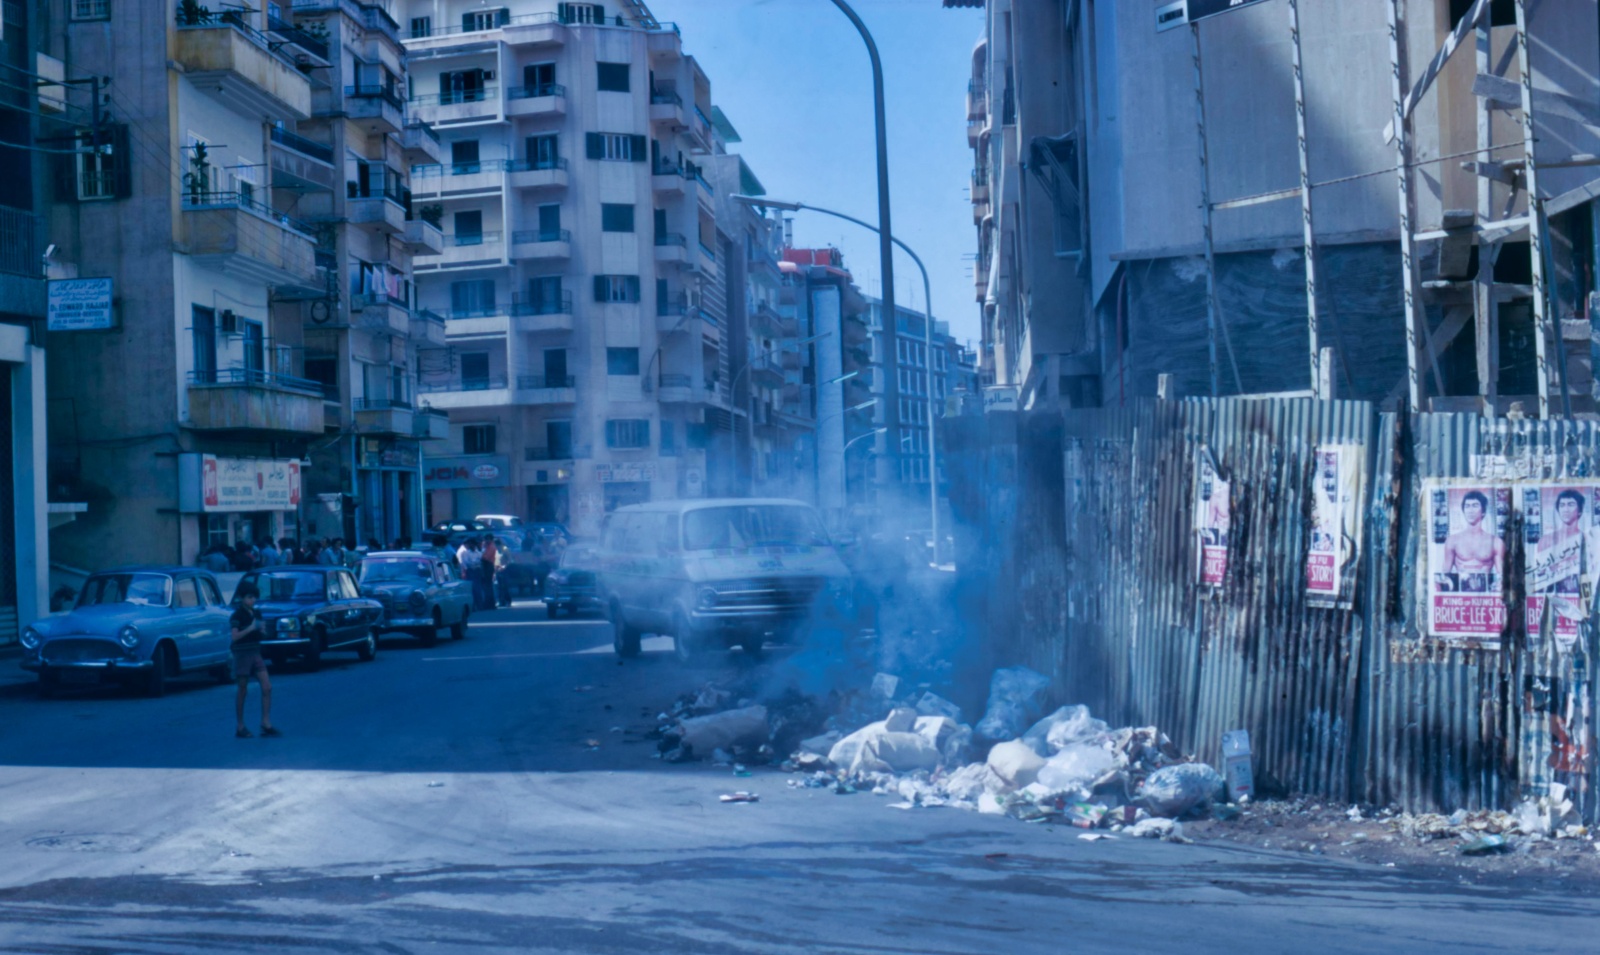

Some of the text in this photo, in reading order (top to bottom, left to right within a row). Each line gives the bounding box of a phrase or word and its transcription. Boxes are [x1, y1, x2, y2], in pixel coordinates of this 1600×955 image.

[58, 303, 84, 311] EDWARD
[85, 301, 109, 309] HAJJAR
[1317, 557, 1328, 565] FU
[1311, 565, 1334, 583] STORY
[1442, 597, 1464, 606] KING
[1471, 597, 1493, 606] KUNG
